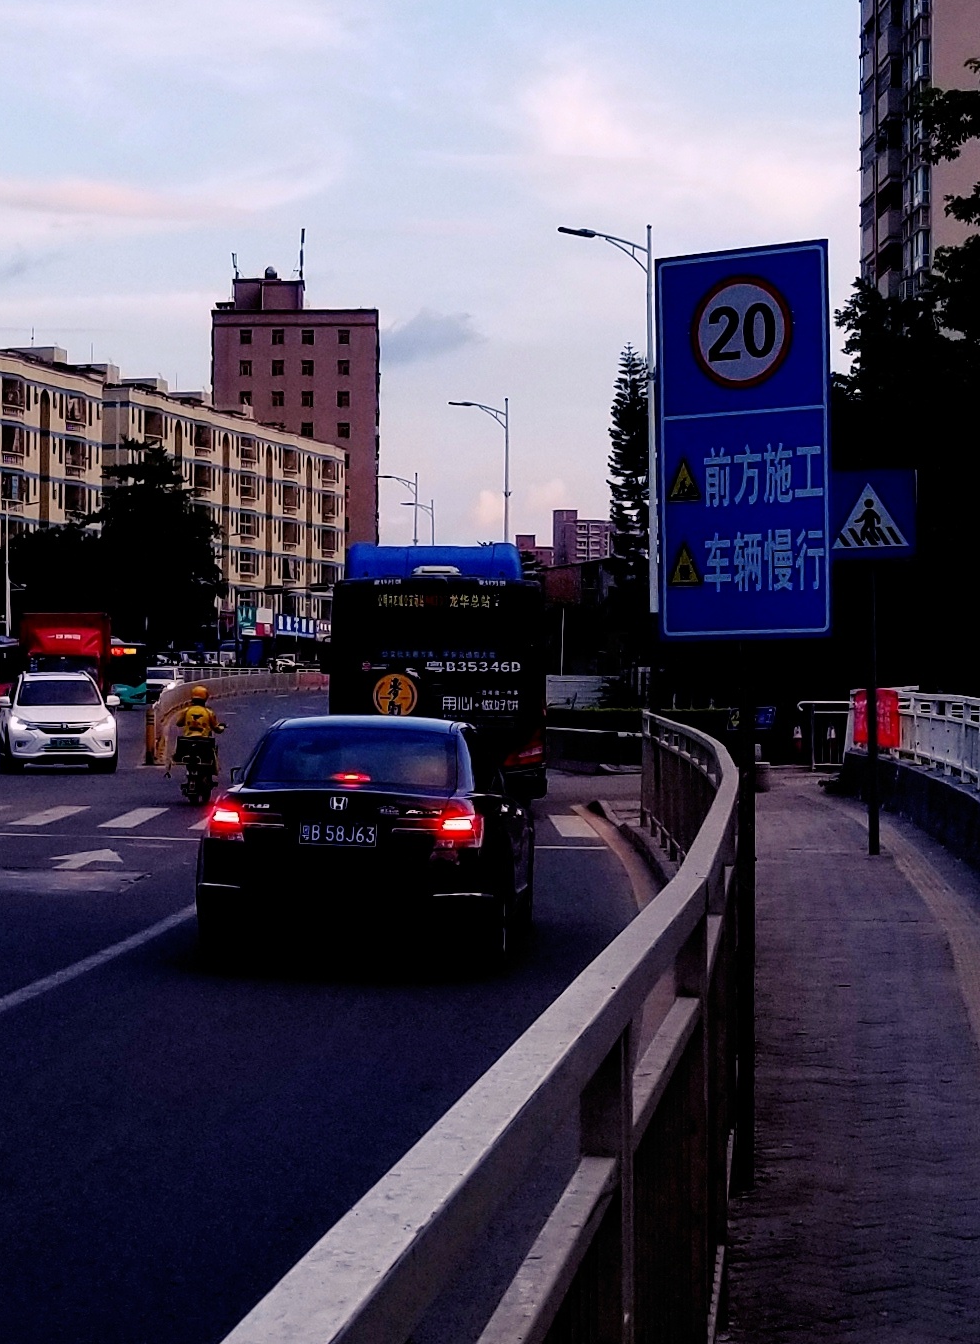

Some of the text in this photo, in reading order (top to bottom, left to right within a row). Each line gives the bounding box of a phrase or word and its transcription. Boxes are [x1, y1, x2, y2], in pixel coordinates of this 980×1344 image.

[708, 302, 776, 363] 20
[704, 443, 824, 507] 前方施工
[704, 529, 825, 592] 车辆慢行
